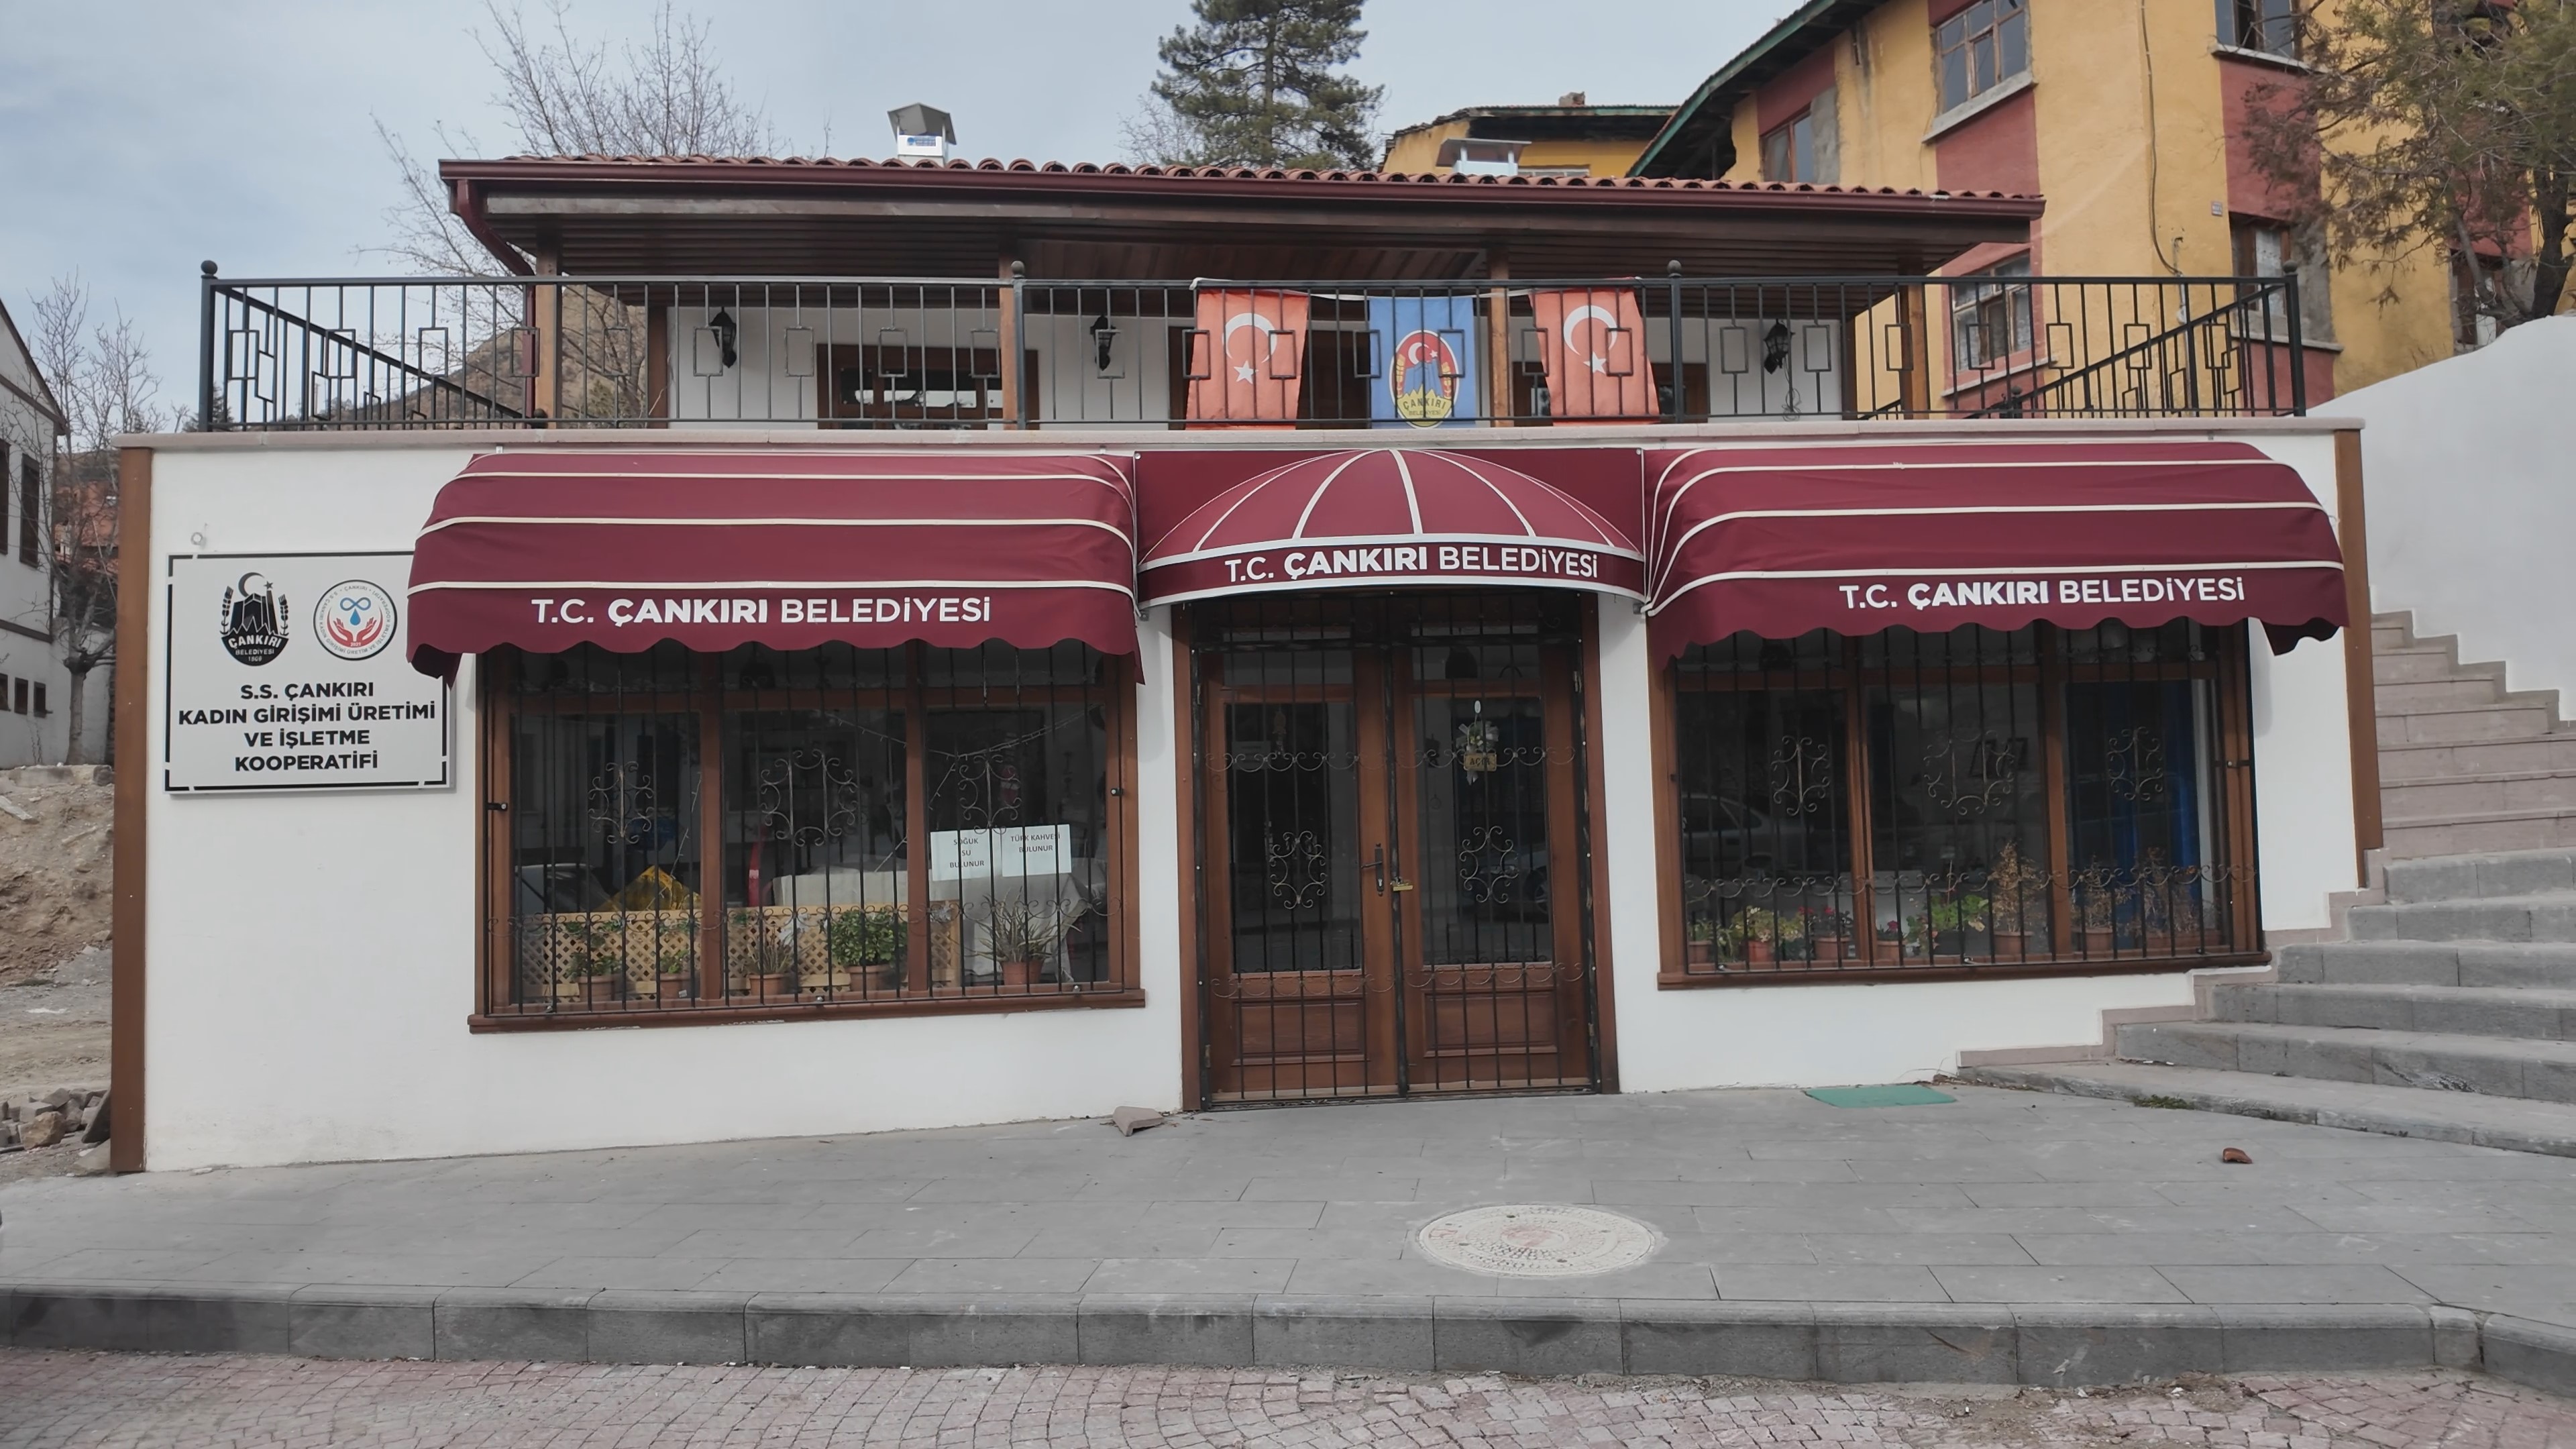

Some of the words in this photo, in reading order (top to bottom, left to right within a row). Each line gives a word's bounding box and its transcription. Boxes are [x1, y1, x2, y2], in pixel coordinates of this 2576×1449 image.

[1225, 556, 1274, 582] T.C.
[1284, 546, 1427, 580] ÇANKIRI
[1440, 546, 1598, 578] BELEDİYESİ
[1839, 584, 1897, 609] T.C.
[1908, 580, 2048, 610] ÇANKIRI
[2060, 576, 2245, 604] BELEDİYESİ
[531, 598, 594, 623] T.C.
[608, 598, 768, 627] ÇANKIRI
[782, 595, 990, 623] BELEDİYESİ
[228, 635, 282, 649] ÇANKIRI
[241, 684, 278, 699] S.S.
[284, 682, 374, 701] ÇANKIRI
[178, 708, 248, 724] KADIN
[254, 703, 341, 725] GİRİŞİMİ
[347, 701, 435, 721] ÜRETİMİ
[244, 732, 273, 747] VE
[280, 729, 370, 749] İŞLETME
[235, 750, 378, 771] KOOPERATİFİ
[1030, 831, 1060, 841] KAHVEİ
[949, 860, 984, 868] BUUNUR
